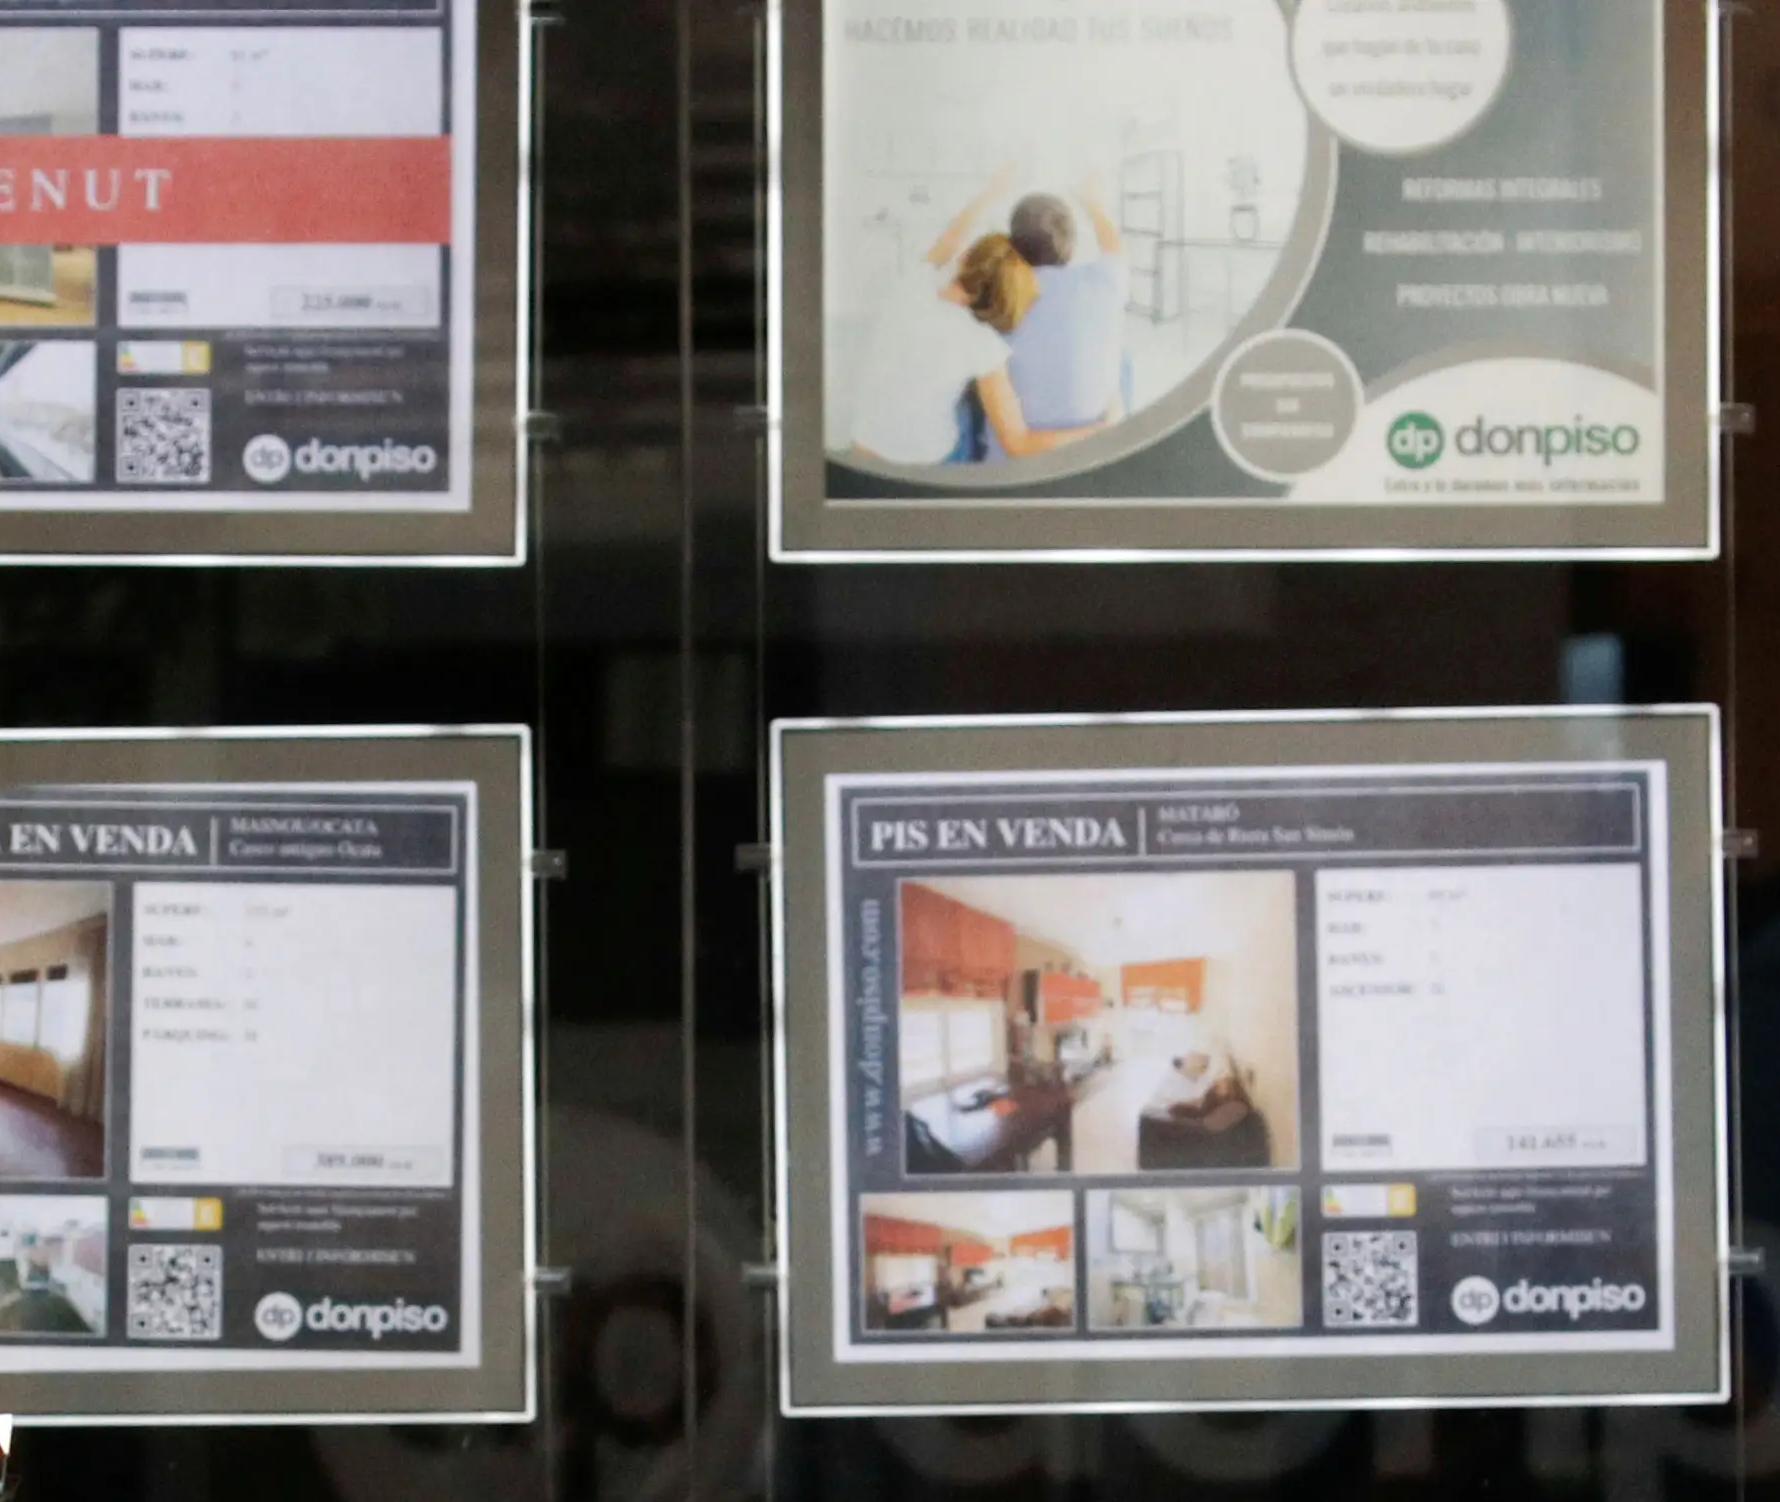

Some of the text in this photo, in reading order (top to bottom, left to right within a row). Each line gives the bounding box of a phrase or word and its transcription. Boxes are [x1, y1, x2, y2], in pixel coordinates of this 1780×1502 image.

[293, 437, 437, 481] donpiso
[1454, 414, 1641, 469] donpiso
[10, 823, 61, 854] EN
[69, 823, 198, 856] VENDA
[871, 817, 1126, 851] PIS EN VENDA
[858, 898, 888, 1156] www.donpiso.com
[305, 1296, 449, 1340] donpiso
[1501, 1277, 1646, 1321] donpiso
